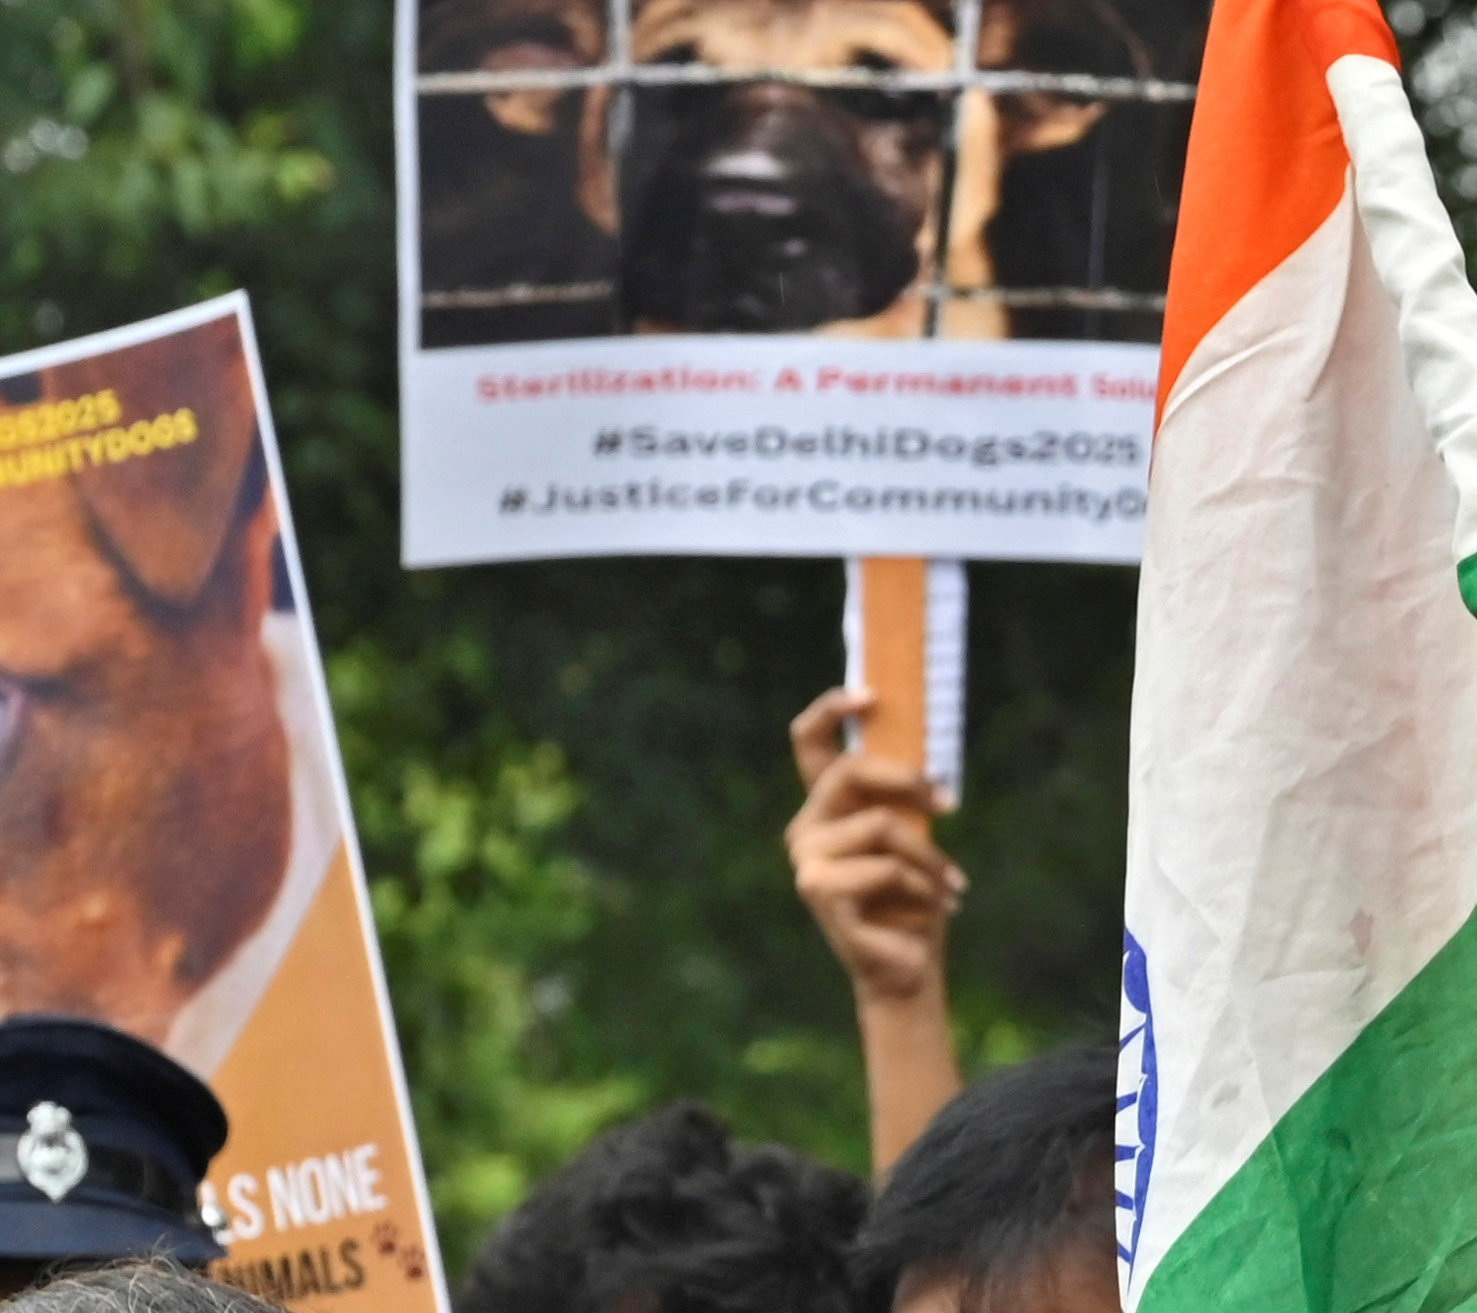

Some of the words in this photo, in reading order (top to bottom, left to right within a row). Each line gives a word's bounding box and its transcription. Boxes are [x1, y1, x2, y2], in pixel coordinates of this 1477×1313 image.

[773, 366, 804, 394] A
[814, 366, 1079, 399] Permanent
[593, 424, 1142, 470] #SaveDelhiDogs2025
[267, 1143, 388, 1232] NONE
